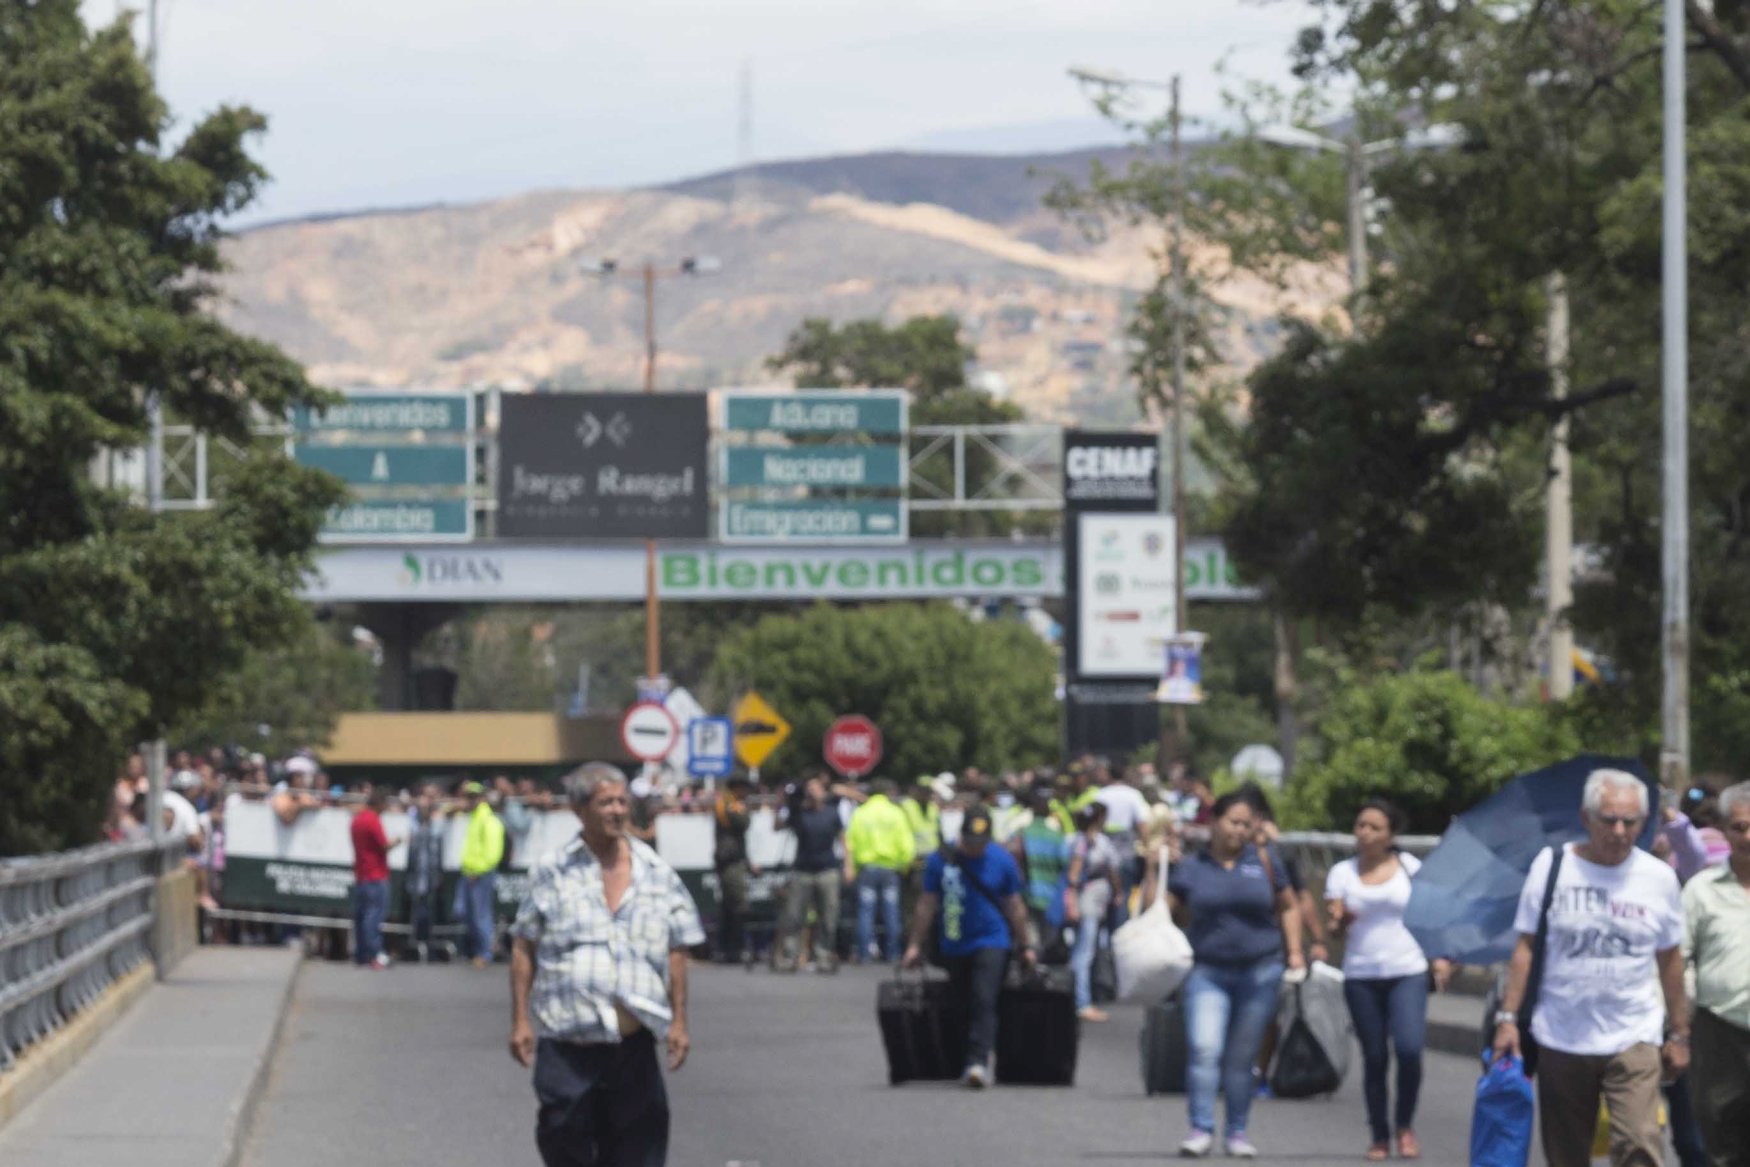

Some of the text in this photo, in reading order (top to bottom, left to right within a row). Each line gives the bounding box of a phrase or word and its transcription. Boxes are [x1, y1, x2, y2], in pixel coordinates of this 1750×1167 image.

[770, 401, 858, 429] Aduana
[370, 450, 389, 481] A
[764, 454, 865, 484] Nacional
[1067, 446, 1157, 479] CENAF
[512, 464, 694, 503] Jorge Rangel
[428, 556, 502, 583] DIAN
[661, 551, 1044, 587] Bienvenidos
[831, 733, 871, 757] PARE
